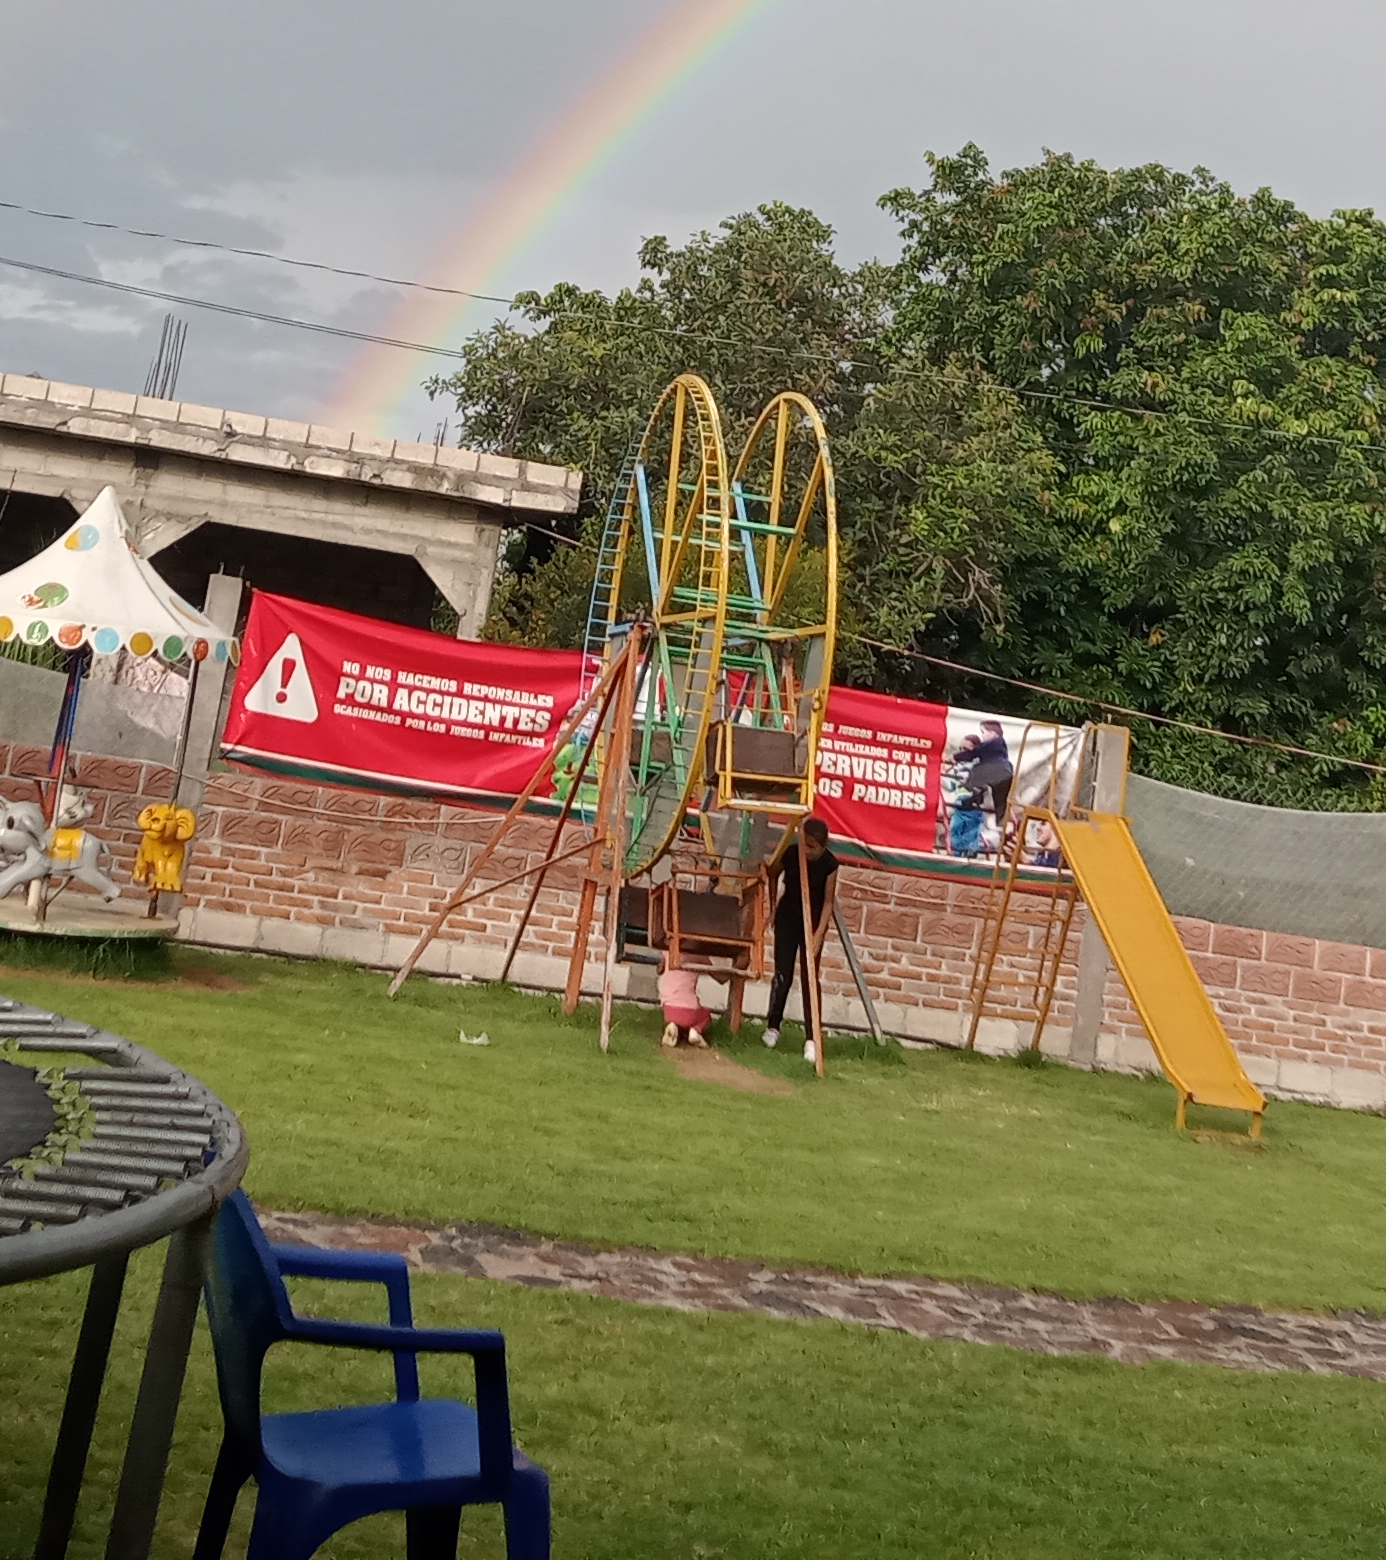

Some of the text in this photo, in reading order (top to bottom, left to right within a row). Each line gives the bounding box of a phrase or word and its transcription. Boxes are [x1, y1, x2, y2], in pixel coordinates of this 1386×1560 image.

[342, 660, 554, 708] NO NOS HACEMOS REPONSABLES
[336, 676, 552, 733] POR ACCIDENTES
[333, 703, 545, 748] OCASIONADOS POR LOS JUEGOS INFANTILES
[838, 725, 873, 739] JUEGOS
[876, 731, 933, 749] INFANTILES
[818, 737, 928, 764] ER UTILIZADOS CON LA
[813, 777, 926, 811] OS PADRES
